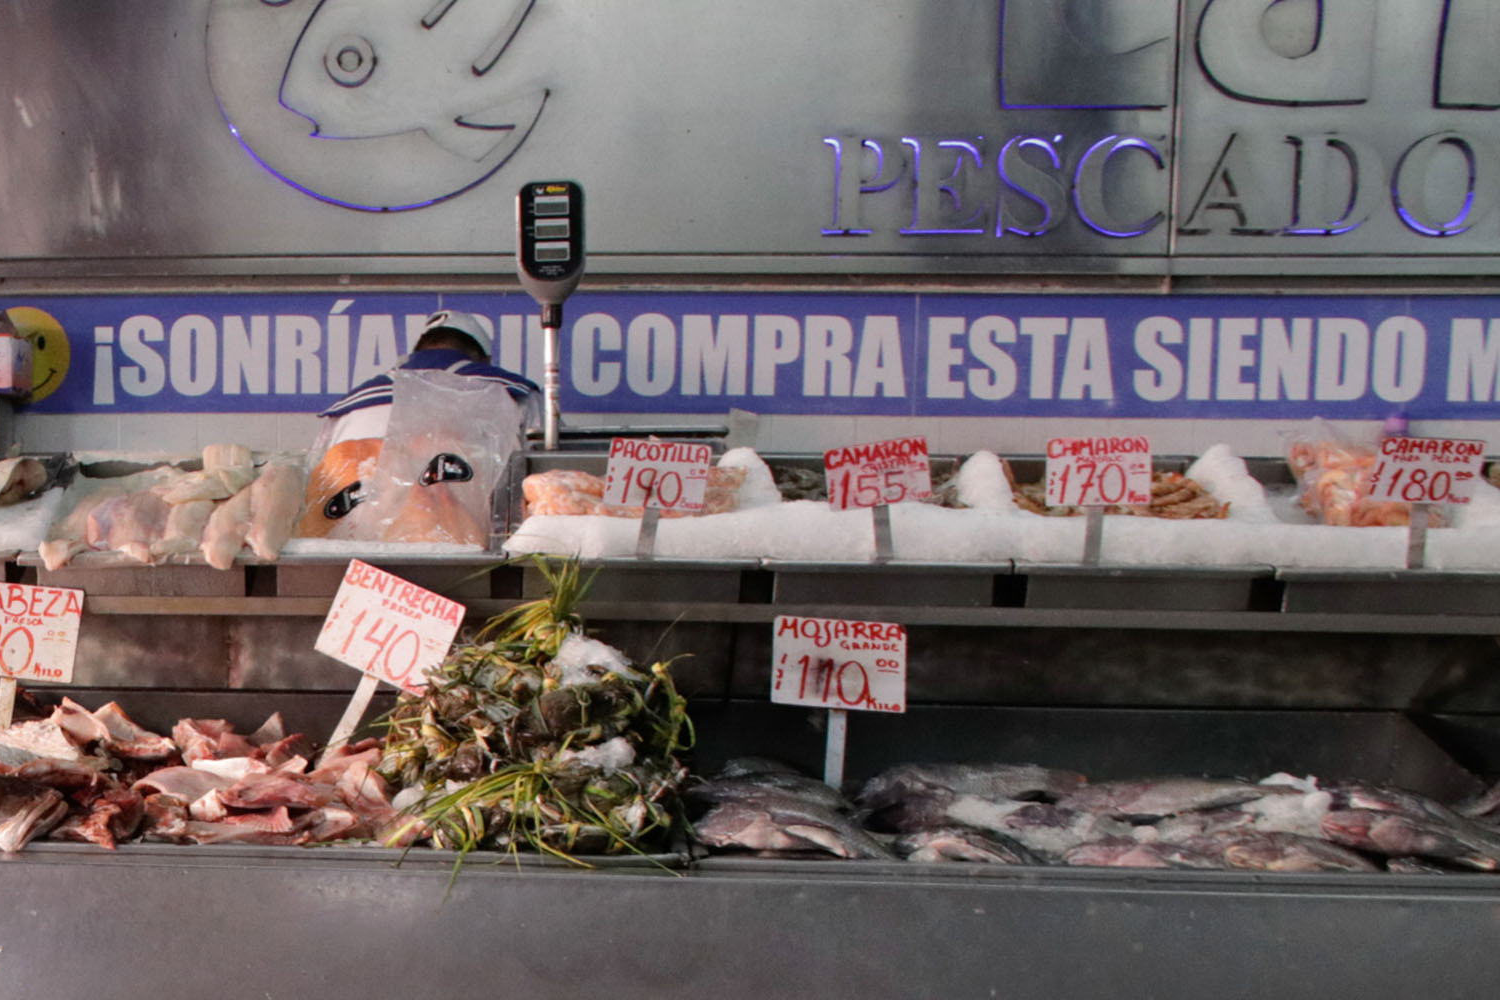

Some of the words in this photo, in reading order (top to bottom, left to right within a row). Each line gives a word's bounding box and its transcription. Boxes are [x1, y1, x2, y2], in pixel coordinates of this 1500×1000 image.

[94, 299, 425, 405] ¡SONRÍA
[571, 312, 906, 399] COMPRA
[926, 315, 1114, 401] ESTA
[1133, 316, 1426, 402] SIENDO
[609, 437, 709, 464] PACOTILLA
[824, 438, 928, 470] CAMARON
[1047, 437, 1149, 459] CAMARON
[1381, 438, 1484, 456] CAMARON
[345, 560, 461, 627] BENTRECHA
[778, 618, 903, 648] MOJARRA
[840, 640, 899, 652] GRANDE
